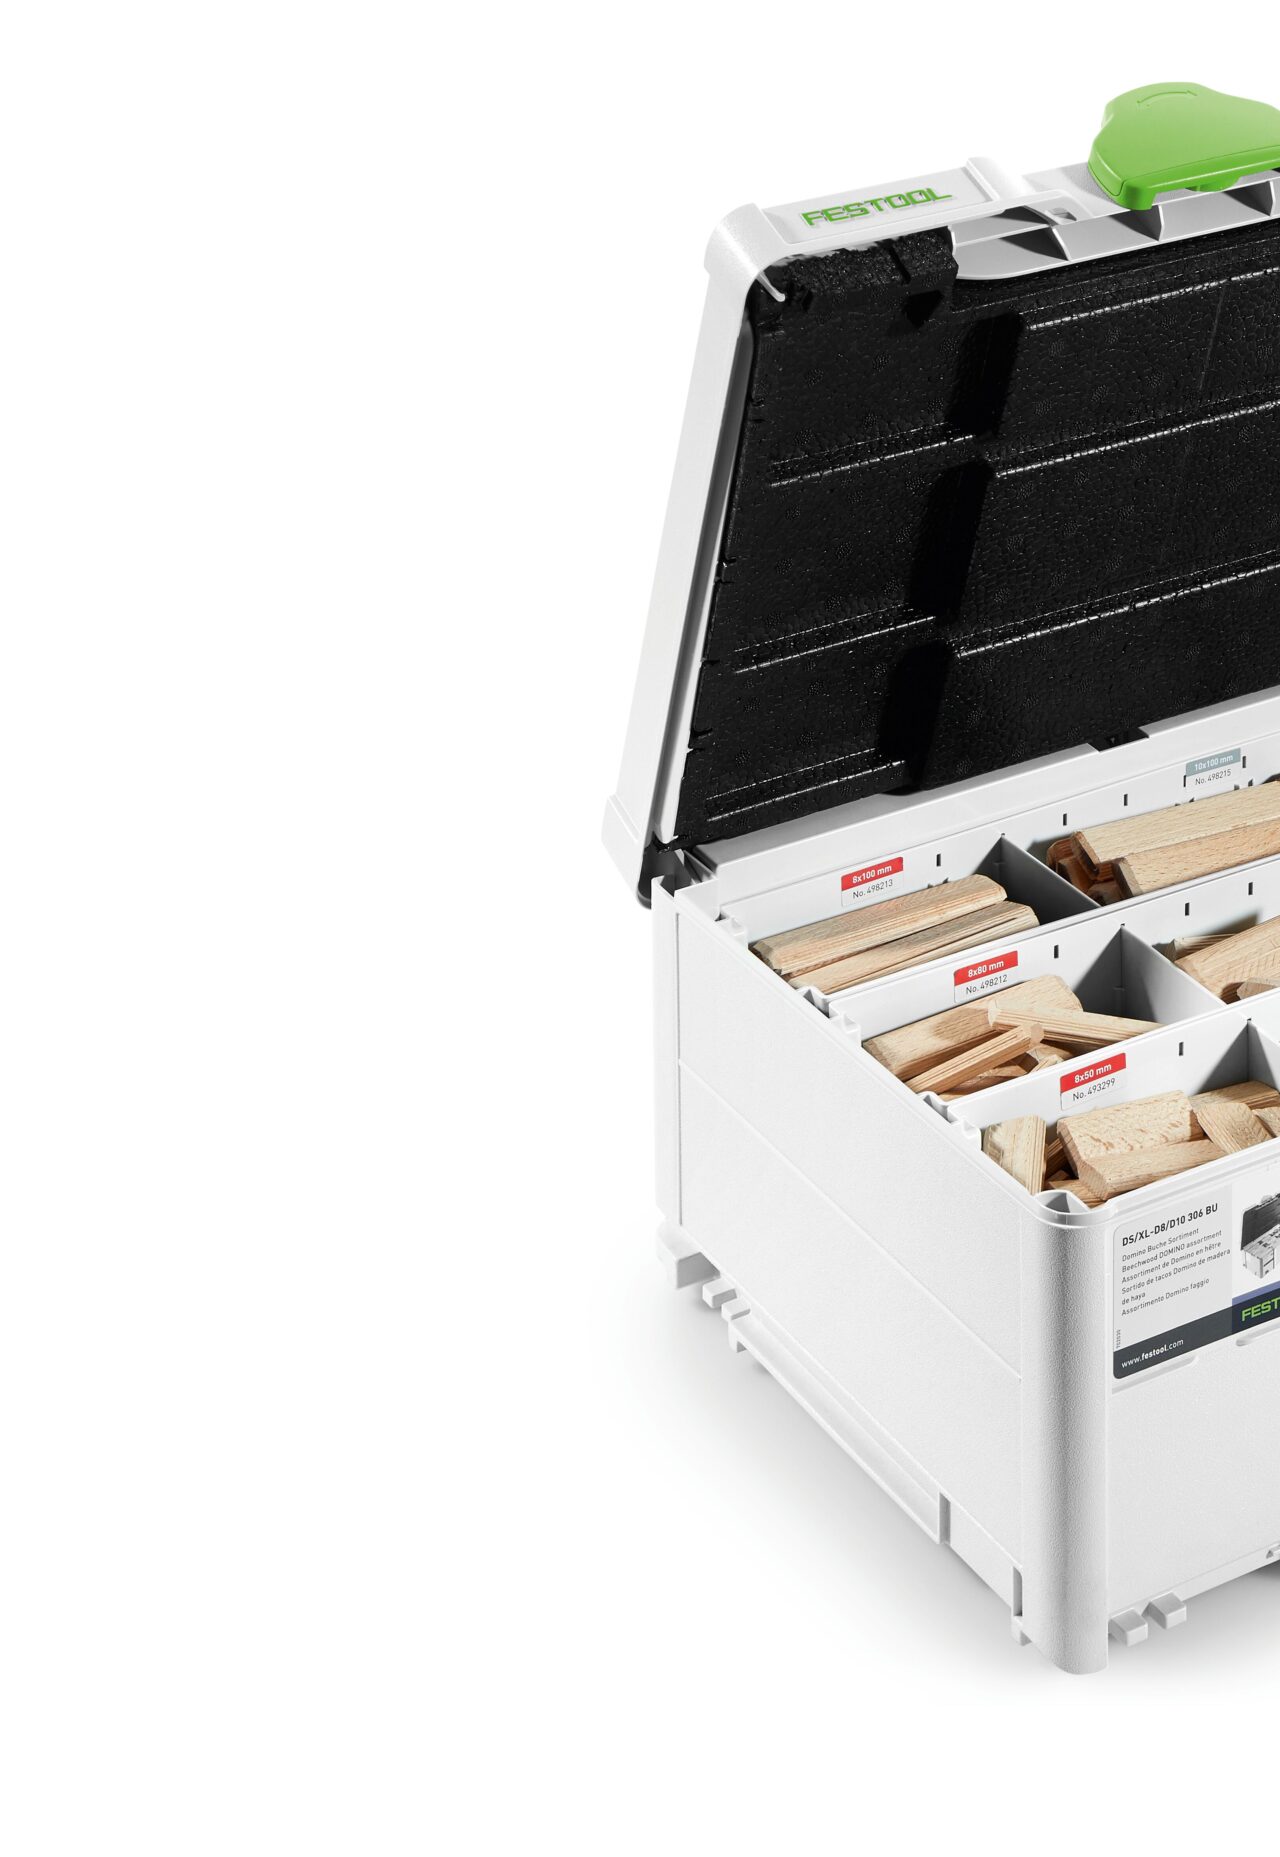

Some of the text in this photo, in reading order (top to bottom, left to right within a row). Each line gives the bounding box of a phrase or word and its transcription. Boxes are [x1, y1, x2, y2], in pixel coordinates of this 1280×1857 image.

[801, 188, 952, 226] FESTOOL
[1194, 754, 1234, 771] 10x100 mm
[1195, 768, 1232, 785] No. 498215
[877, 865, 892, 876] mm
[852, 878, 893, 899] No. 498213
[967, 960, 1005, 978] 8x80 mm
[966, 974, 1008, 995] No. 498212
[1074, 1063, 1112, 1083] 8x50 mm
[1072, 1077, 1115, 1101] No. 493299
[1122, 1202, 1218, 1246] DS/XL-D8/D10 306 BU
[1122, 1228, 1199, 1262] Domino Buche Sortiment
[1122, 1229, 1222, 1273] Beechwood DOMINO assortment
[1121, 1263, 1161, 1284] Assortiment
[1161, 1259, 1170, 1269] de
[1170, 1251, 1194, 1265] Domino
[1204, 1241, 1222, 1253] hêtre
[1121, 1281, 1145, 1295] Sortido
[1146, 1276, 1154, 1286] de
[1155, 1270, 1172, 1281] tacos
[1173, 1262, 1197, 1275] Domino
[1206, 1248, 1231, 1263] madera
[1121, 1277, 1210, 1316] Assortimento Domino faggio
[1121, 1291, 1146, 1306] de haya
[1121, 1339, 1184, 1369] www.festool.com
